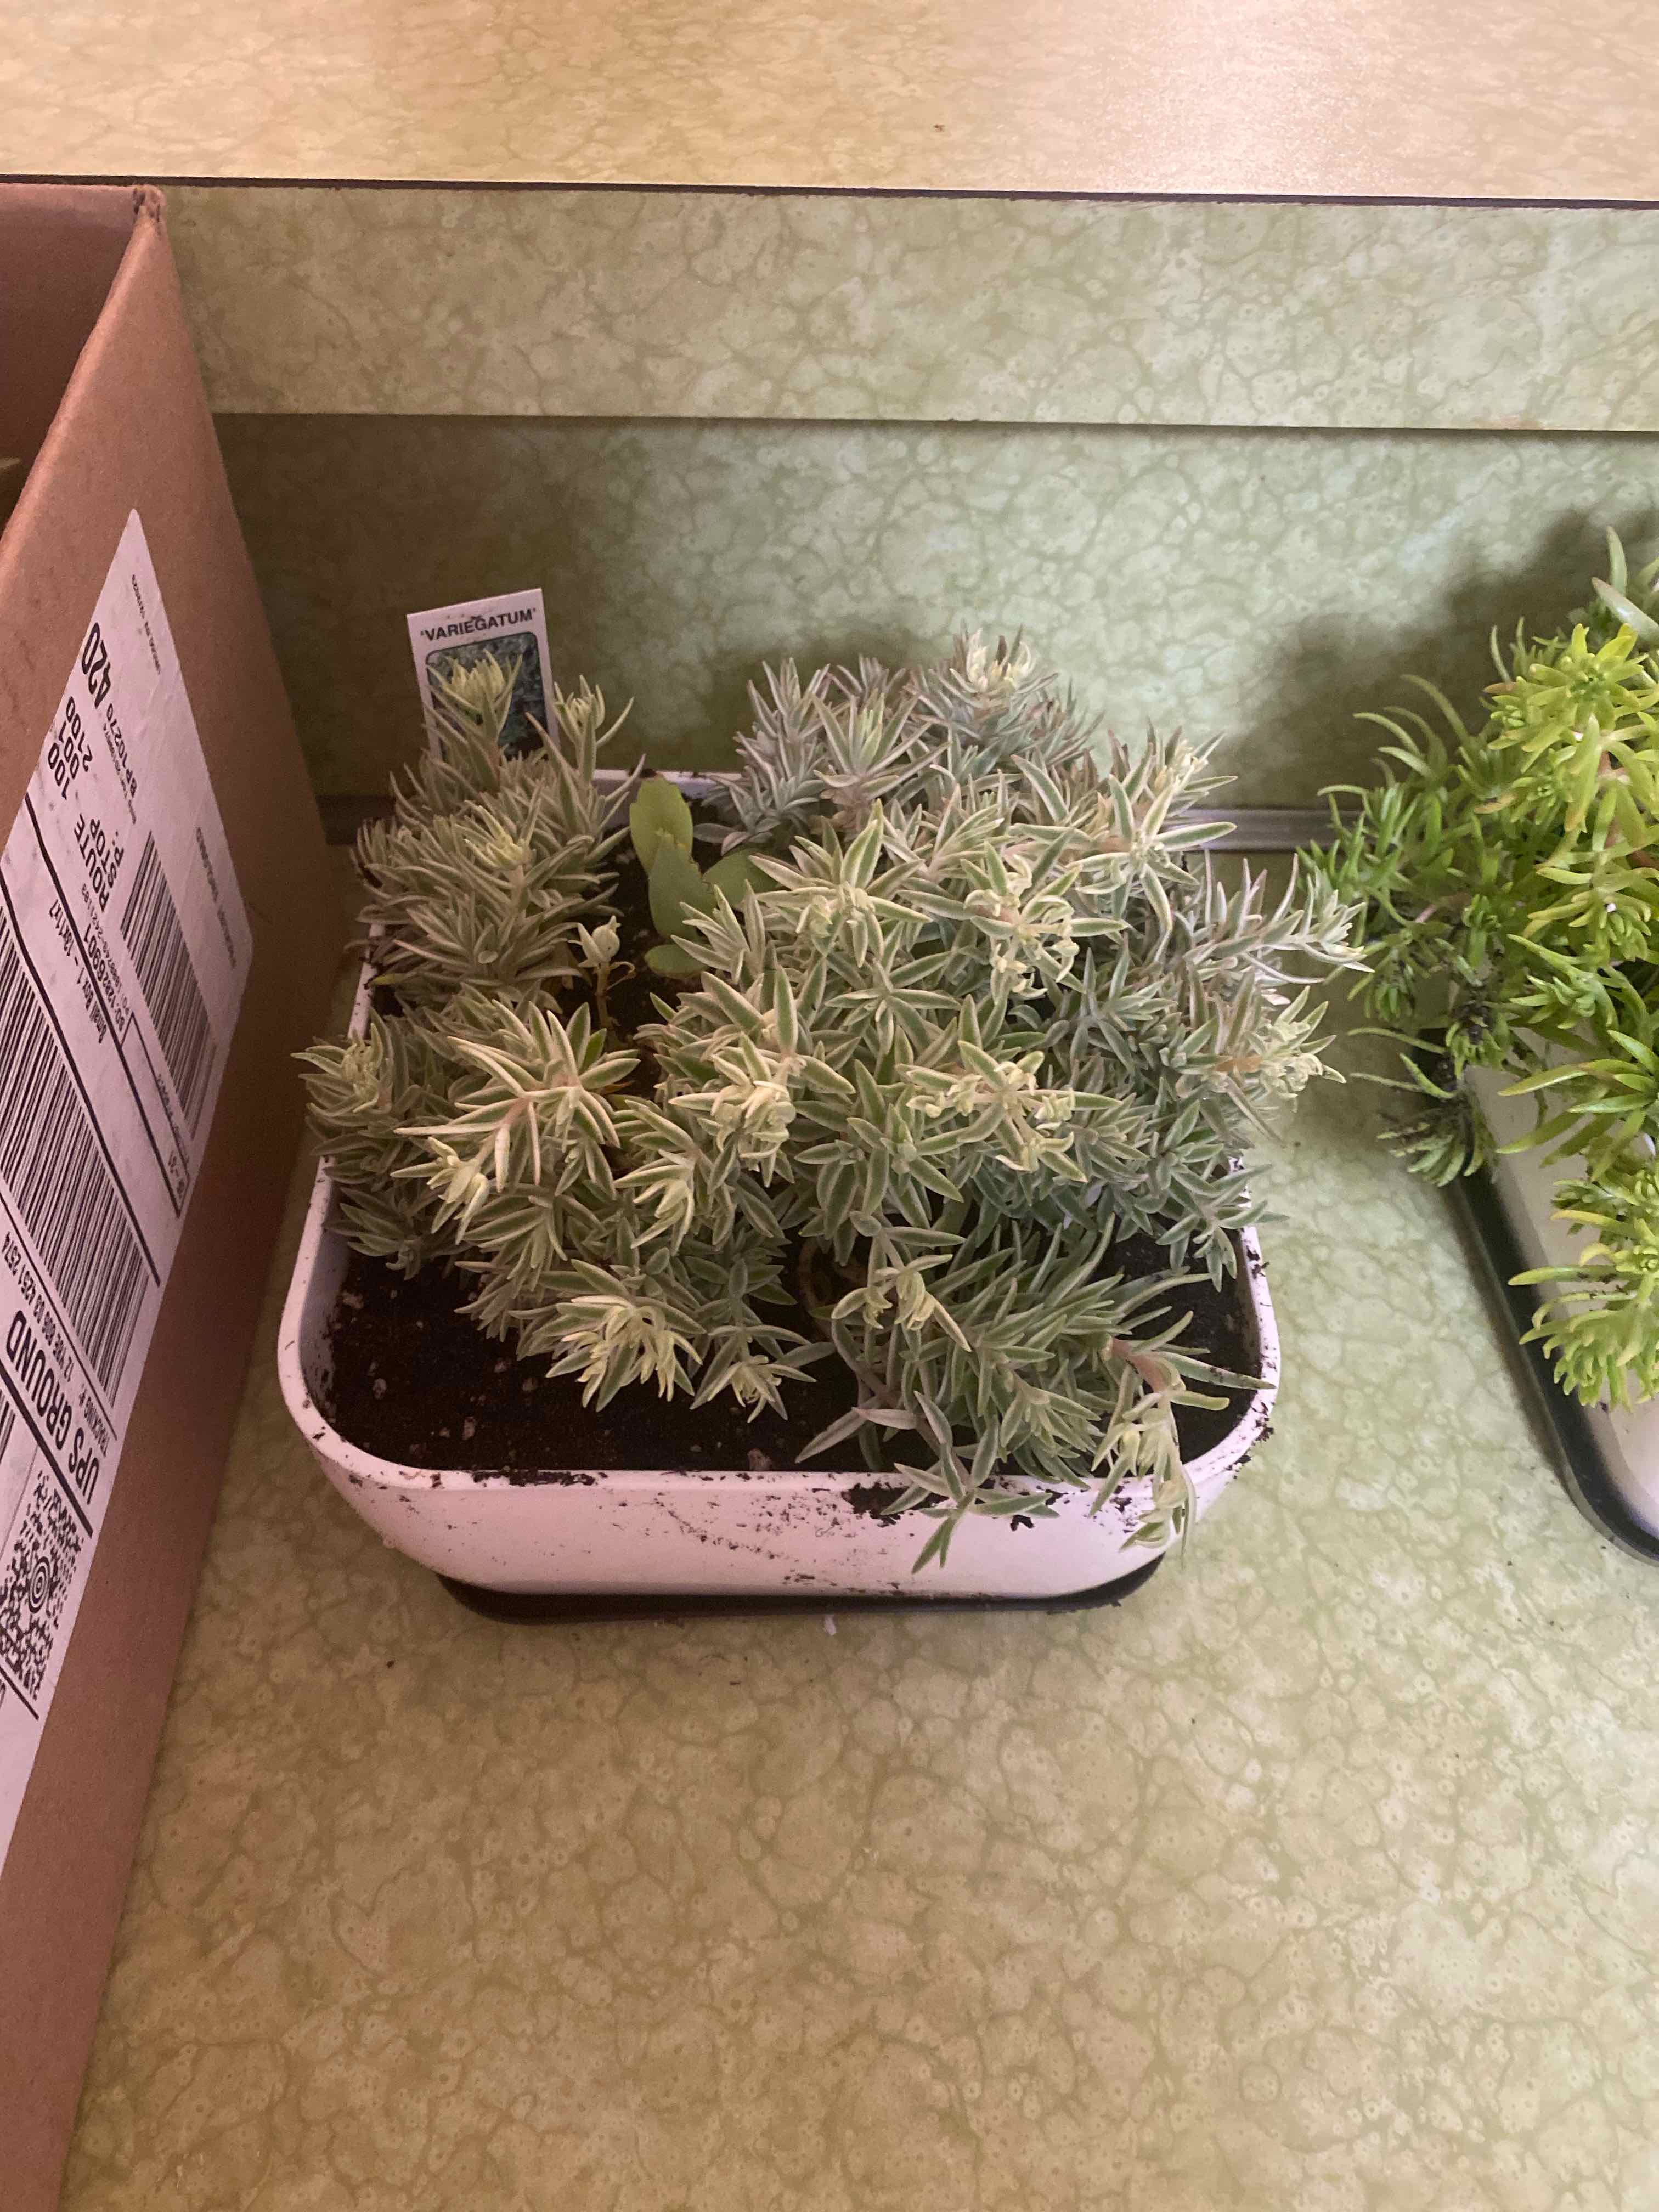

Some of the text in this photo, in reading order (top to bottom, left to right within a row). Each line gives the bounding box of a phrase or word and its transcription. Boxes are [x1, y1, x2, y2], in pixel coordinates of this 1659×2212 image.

[81, 622, 111, 709] 420
[47, 742, 110, 912] ROUTE 100
[58, 720, 117, 889] STOP 001
[65, 696, 125, 867] P: 2100
[1, 1231, 21, 1276] 2574
[5, 1310, 100, 1505] UPS GROUND
[83, 1395, 110, 1457] TRACKING
